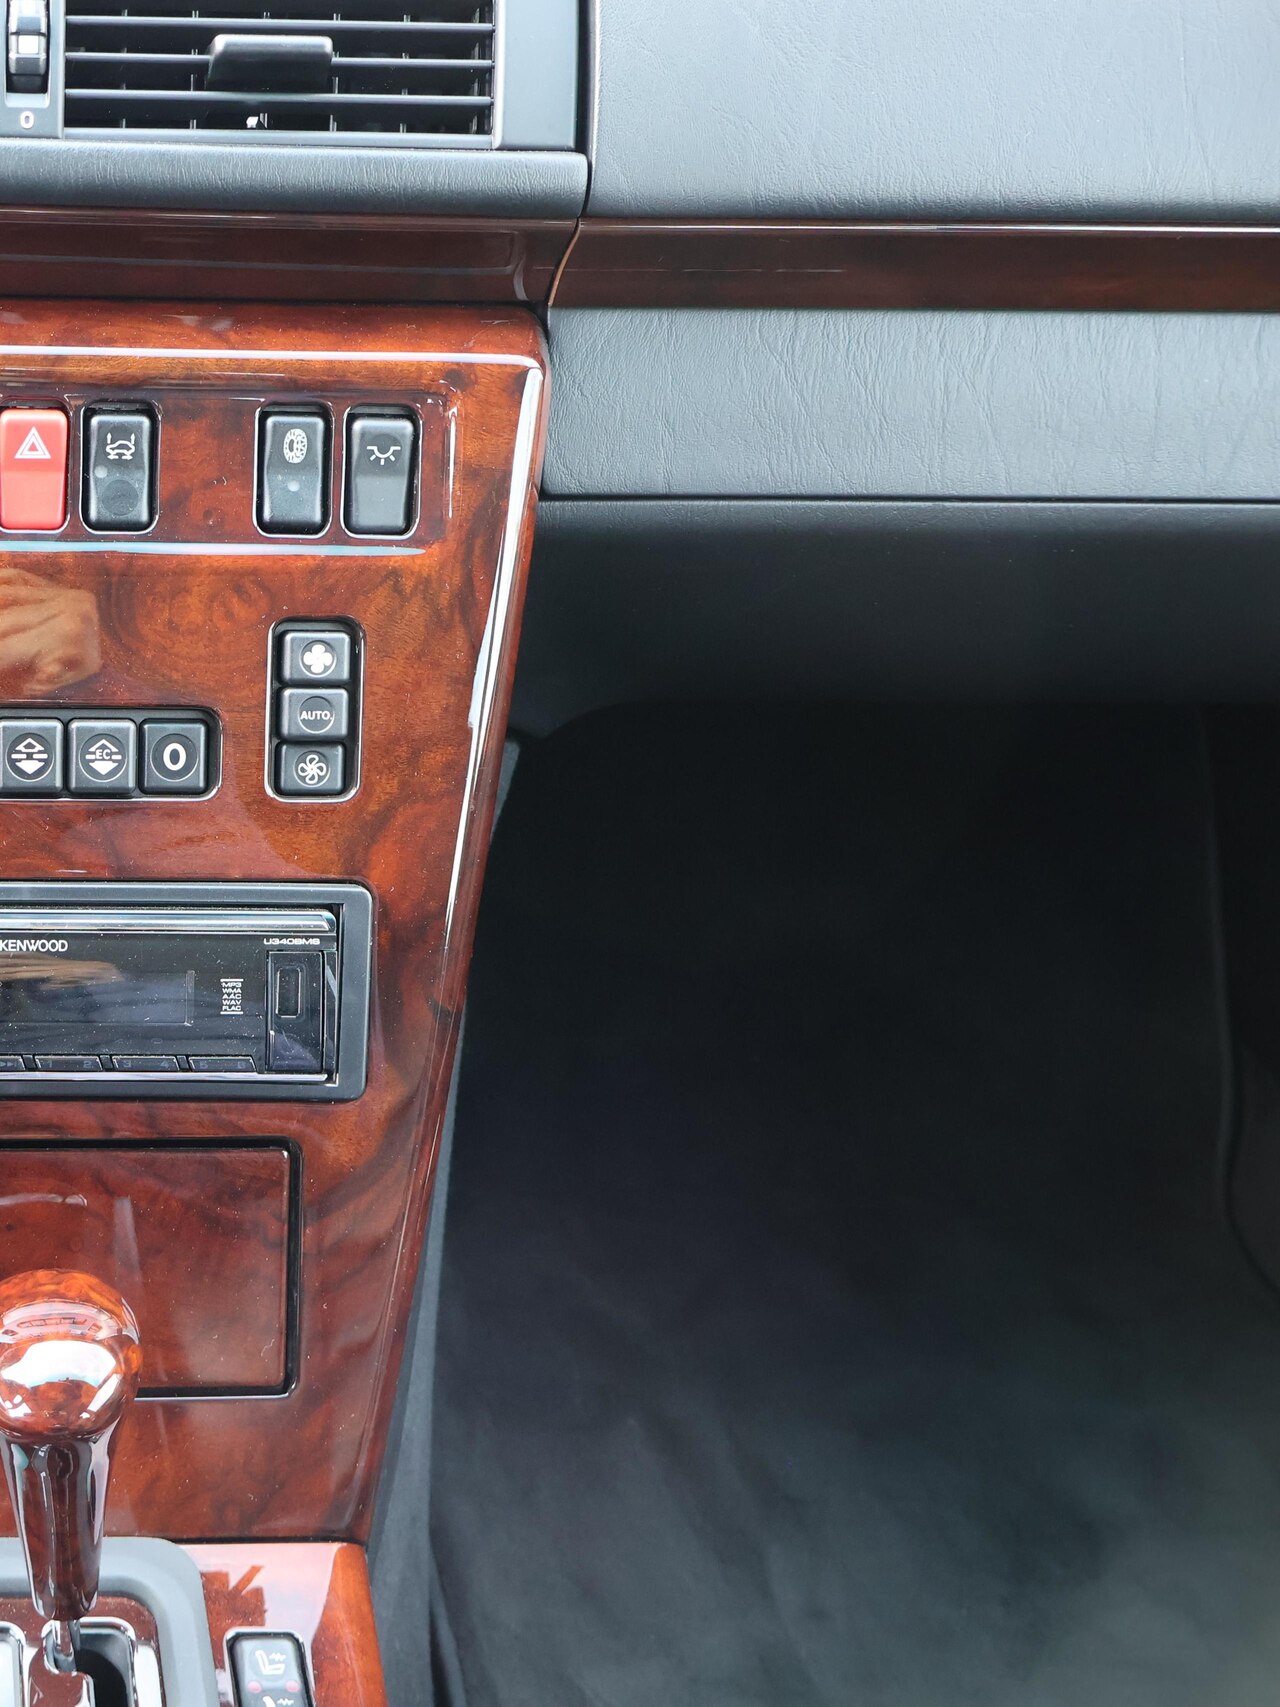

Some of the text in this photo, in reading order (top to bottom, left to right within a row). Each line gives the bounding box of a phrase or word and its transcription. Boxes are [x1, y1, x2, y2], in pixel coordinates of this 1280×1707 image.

[95, 750, 111, 760] EC
[0, 939, 68, 952] KENWOOD
[83, 1060, 93, 1068] 2
[123, 1060, 132, 1068] 3
[159, 1060, 170, 1068] 4
